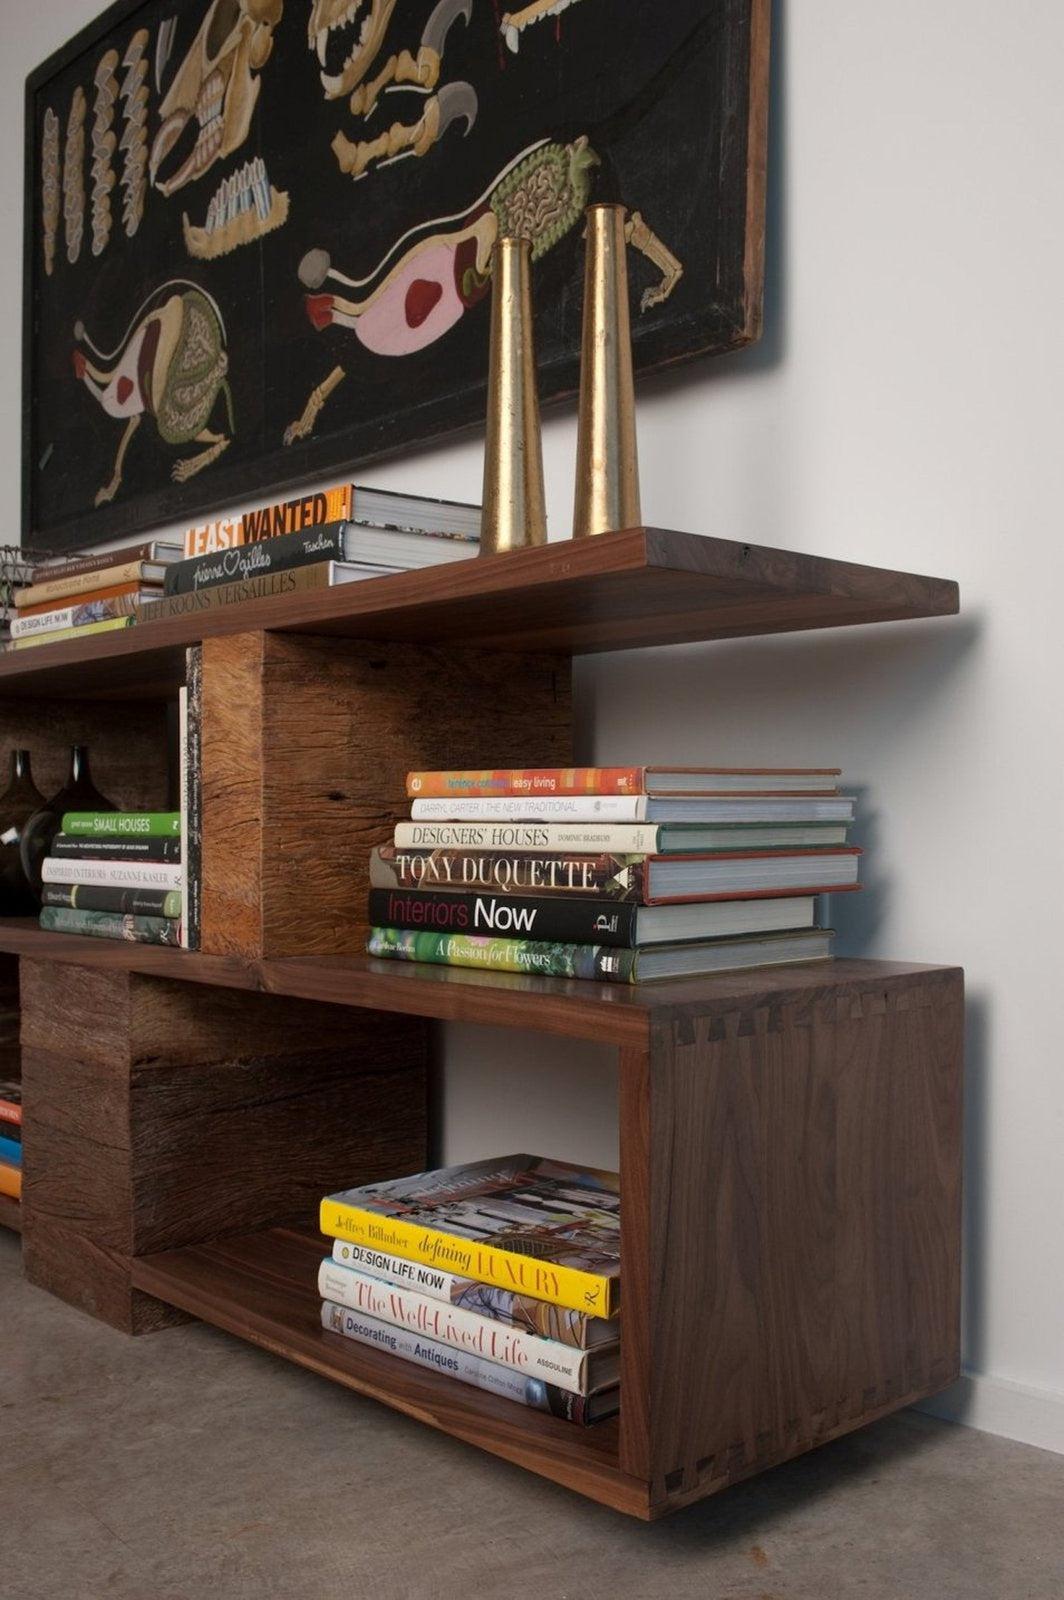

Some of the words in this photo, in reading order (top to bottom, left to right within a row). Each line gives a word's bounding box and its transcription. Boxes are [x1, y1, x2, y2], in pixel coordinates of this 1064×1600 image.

[184, 518, 243, 560] LEAST
[242, 493, 328, 544] WANTED
[169, 593, 211, 615] KOONS
[216, 570, 297, 605] VERSAILLES
[513, 778, 532, 790] easy
[533, 776, 556, 791] living
[93, 818, 118, 831] SMALL
[119, 818, 150, 832] HOUSES
[450, 802, 479, 814] CARTER
[486, 802, 502, 813] THE
[502, 802, 521, 813] NEW
[523, 801, 578, 813] TRADITIONAL
[491, 828, 549, 846] HOUSES
[396, 855, 456, 882] TONY
[462, 856, 599, 892] DUQUETTE
[388, 893, 469, 927] Interiors
[474, 897, 537, 932] Now
[435, 939, 445, 956] A
[446, 939, 487, 960] Passion
[486, 944, 504, 965] for
[504, 944, 551, 967] Flowers
[352, 1247, 390, 1271] DESIGN
[392, 1259, 415, 1281] LIFE
[417, 1269, 445, 1290] NOW
[416, 1234, 472, 1271] defining
[476, 1252, 560, 1297] LUXURY
[355, 1280, 386, 1313] The
[390, 1293, 484, 1352] Well-Lived
[491, 1331, 529, 1367] Life
[345, 1317, 398, 1350] Decorating
[414, 1342, 460, 1371] Antiques
[536, 1357, 573, 1377] ASSOULINE
